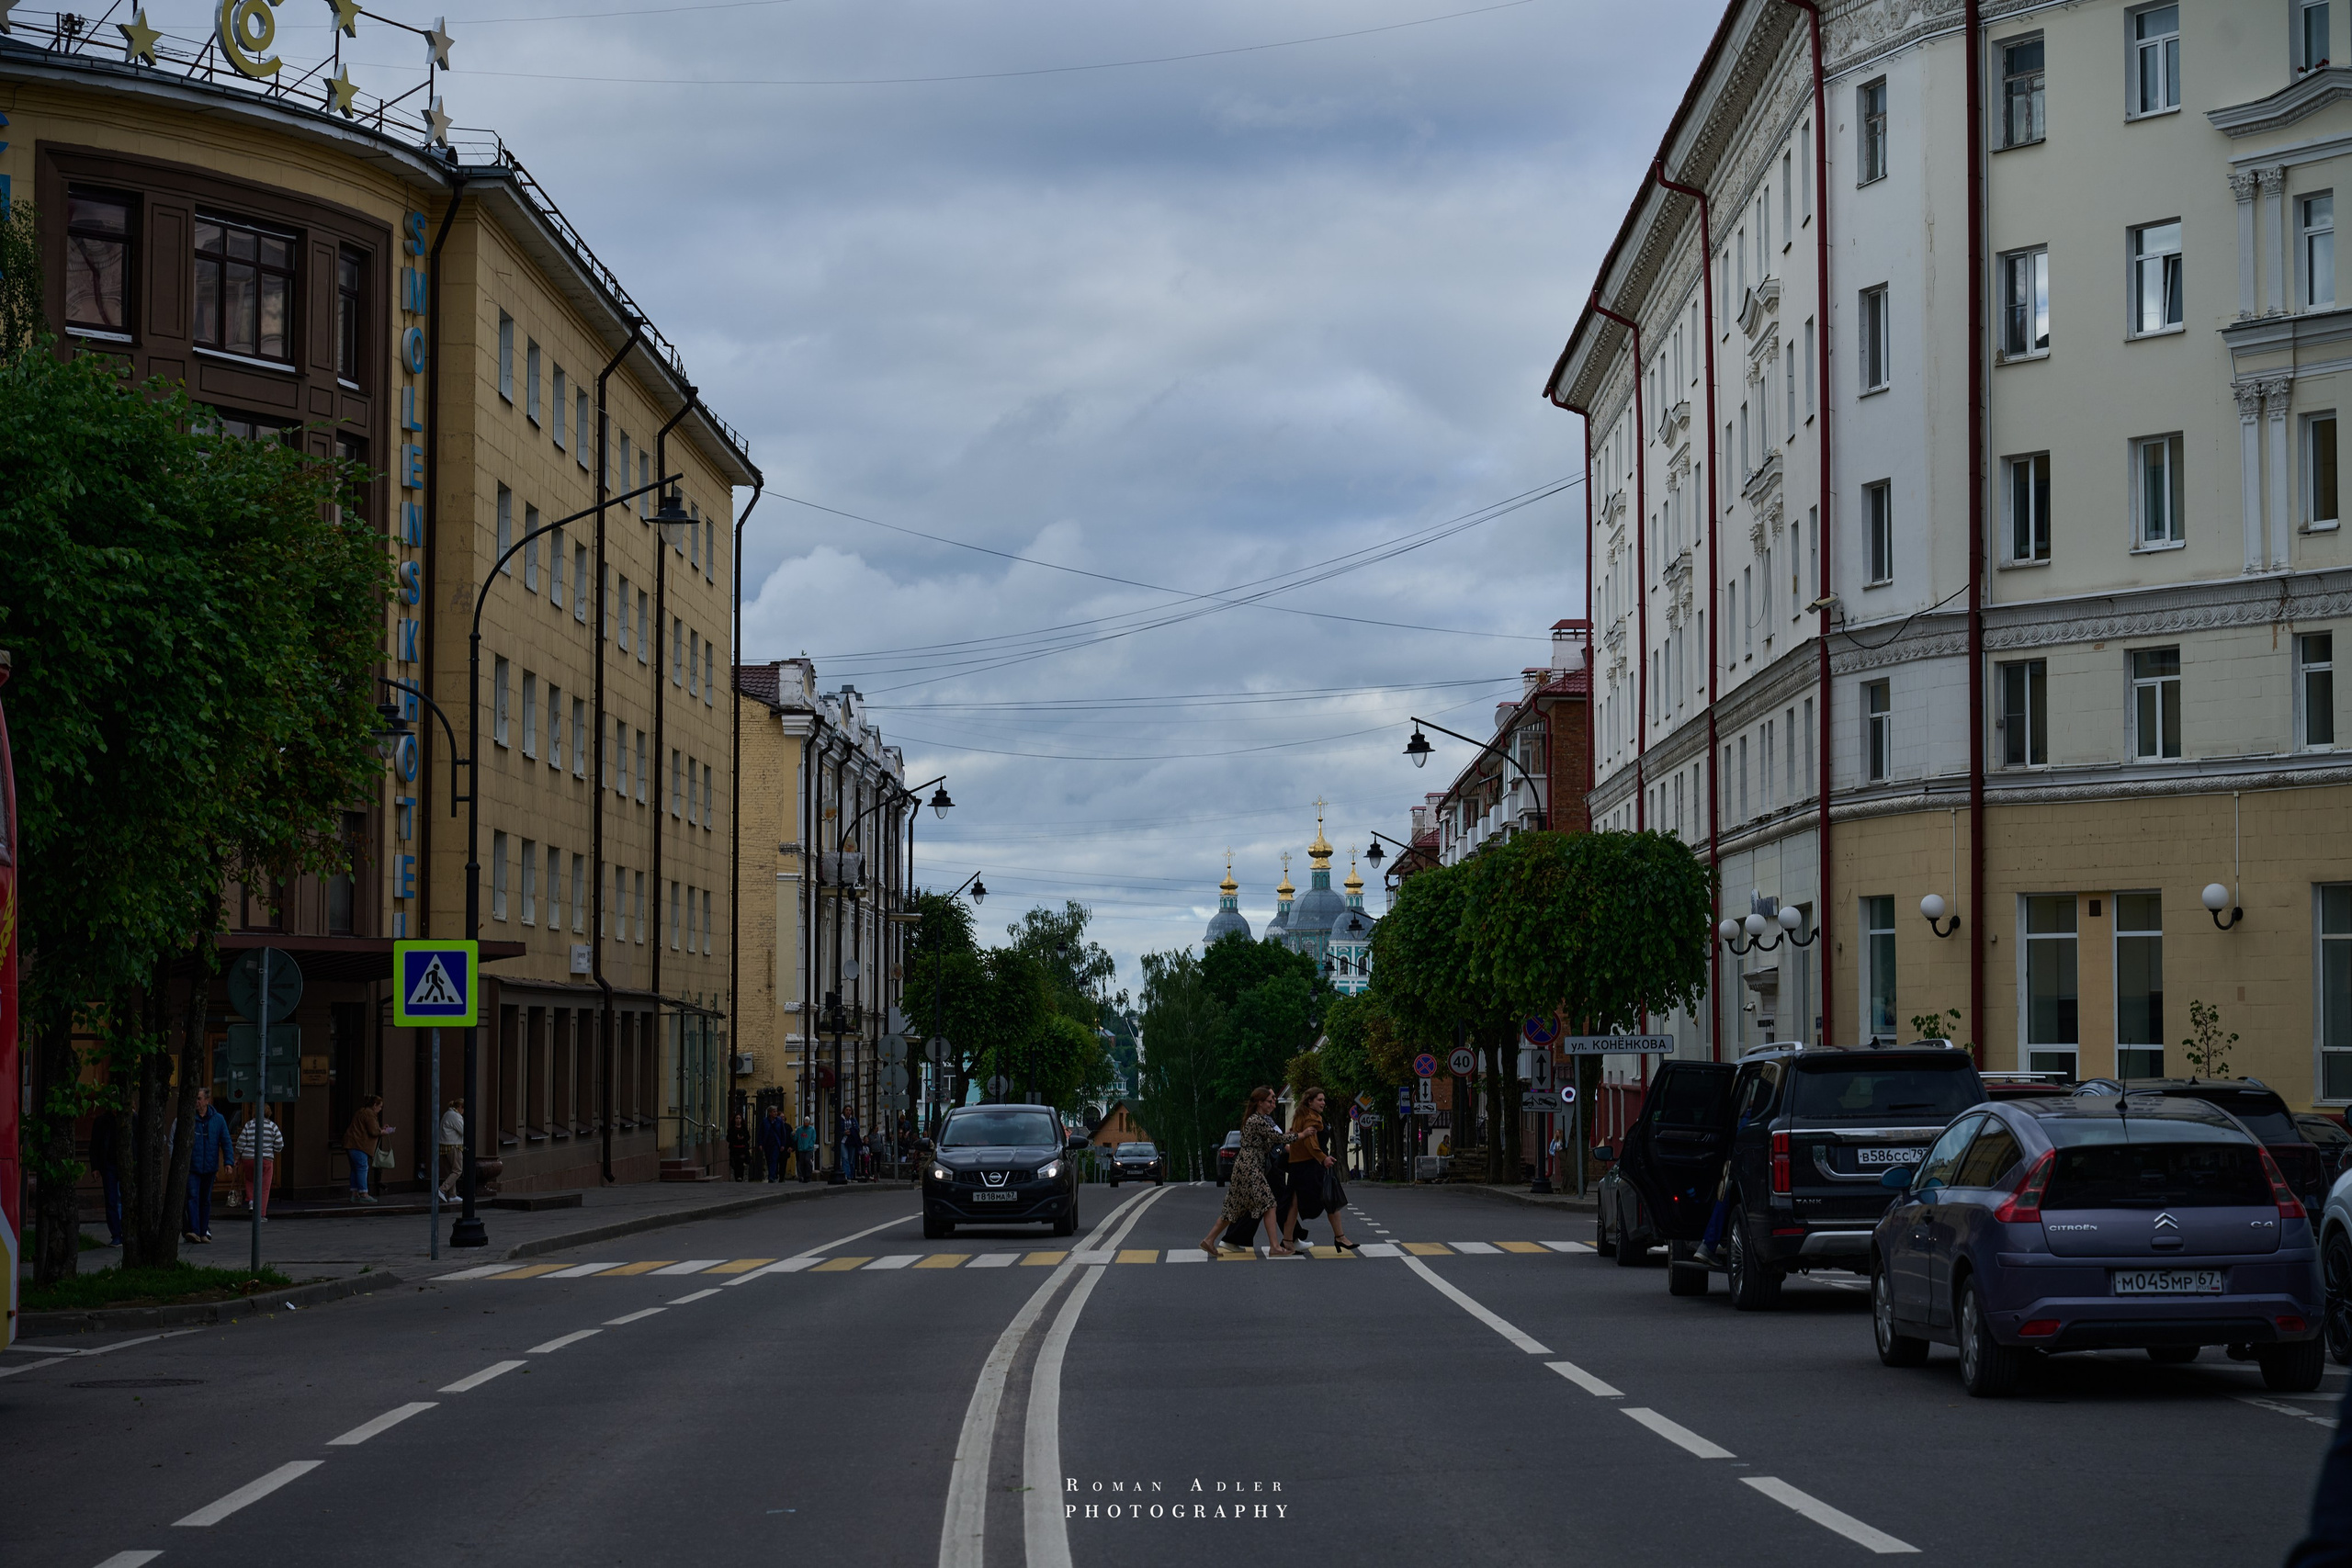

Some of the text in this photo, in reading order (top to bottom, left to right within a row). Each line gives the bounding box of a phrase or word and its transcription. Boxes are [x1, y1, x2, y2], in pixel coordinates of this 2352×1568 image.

[400, 210, 427, 664] SMOLENSK
[1571, 1037, 1667, 1053] ул. КОНЁНКОВА
[1453, 1055, 1470, 1068] 40
[2048, 1223, 2098, 1233] CITROËN
[2250, 1220, 2276, 1229] C4
